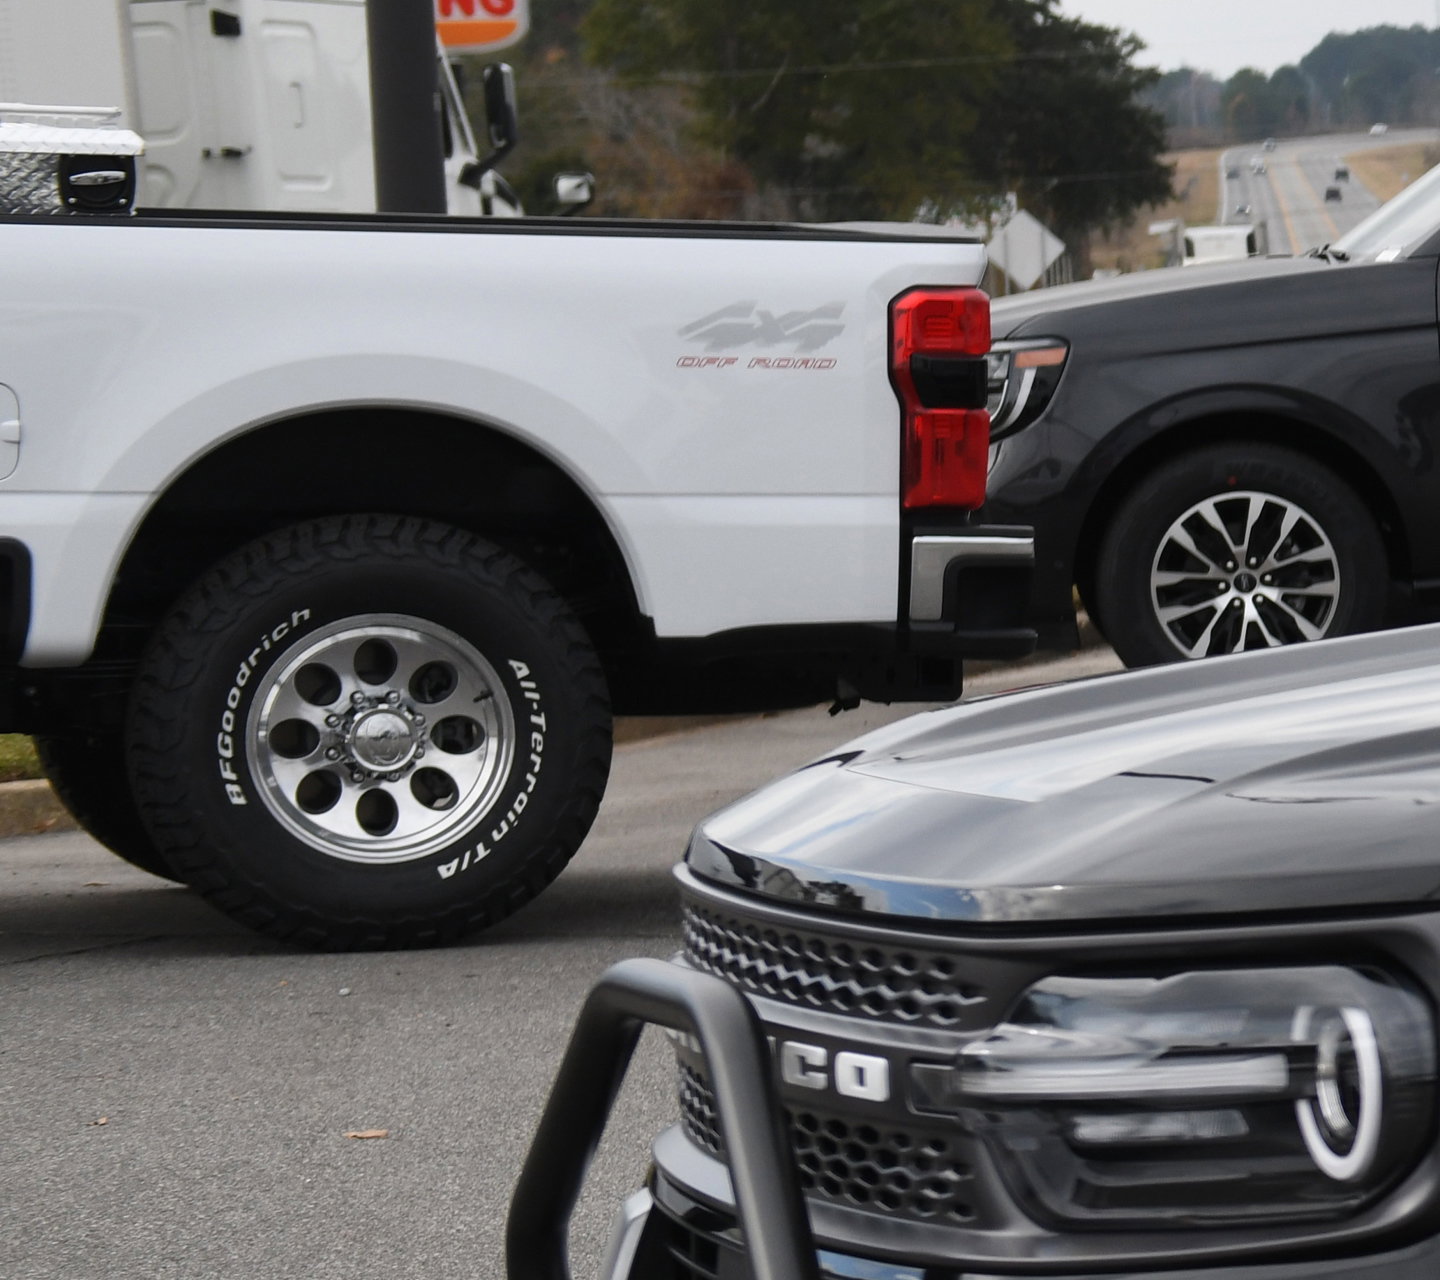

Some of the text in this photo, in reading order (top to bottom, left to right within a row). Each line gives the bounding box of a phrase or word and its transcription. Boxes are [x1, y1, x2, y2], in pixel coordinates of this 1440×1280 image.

[676, 355, 838, 370] OFF ROAD
[217, 606, 312, 806] BFGoodrich
[436, 658, 548, 881] All-Terrain T/A
